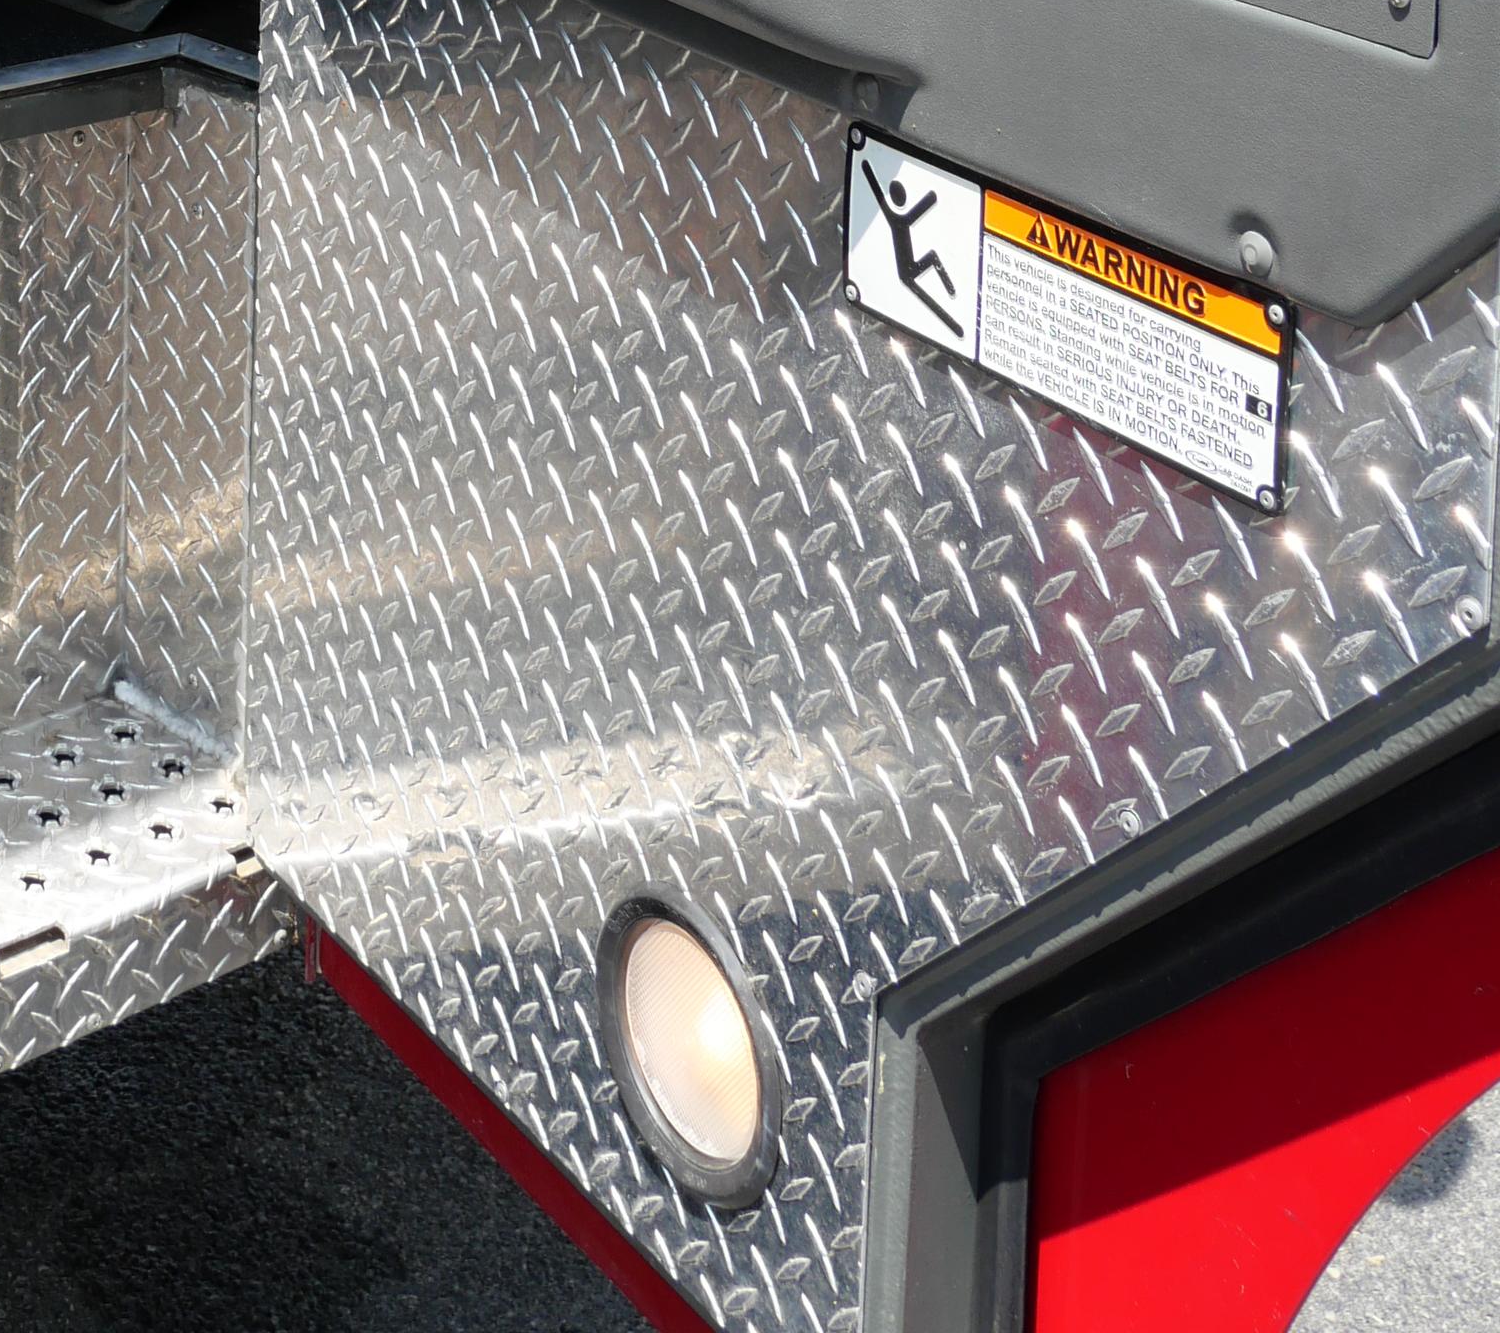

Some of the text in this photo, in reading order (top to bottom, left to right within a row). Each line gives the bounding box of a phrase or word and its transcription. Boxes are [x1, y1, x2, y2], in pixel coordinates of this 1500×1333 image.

[986, 264, 1260, 395] personnel in a SEATED POSITION ONLY. This
[987, 243, 1201, 353] This vehicle is designed for carrying
[1054, 224, 1207, 318] WARNING
[984, 328, 1027, 360] Remain
[1030, 353, 1069, 381] seated
[1072, 373, 1097, 393] with
[1100, 384, 1134, 409] SEAT
[1136, 401, 1177, 431] BELTS
[1180, 423, 1253, 469] FASTENED
[984, 348, 1181, 453] while the VEHICLE IS IN MOTION.
[985, 314, 1240, 444] can result in SERIOUS INJURY OR DEATH.
[986, 281, 1269, 419] vehicle is equipped with SEAT BELTS FOR 6
[986, 294, 1265, 438] PERSONS. Standing while vehicle is in motion
